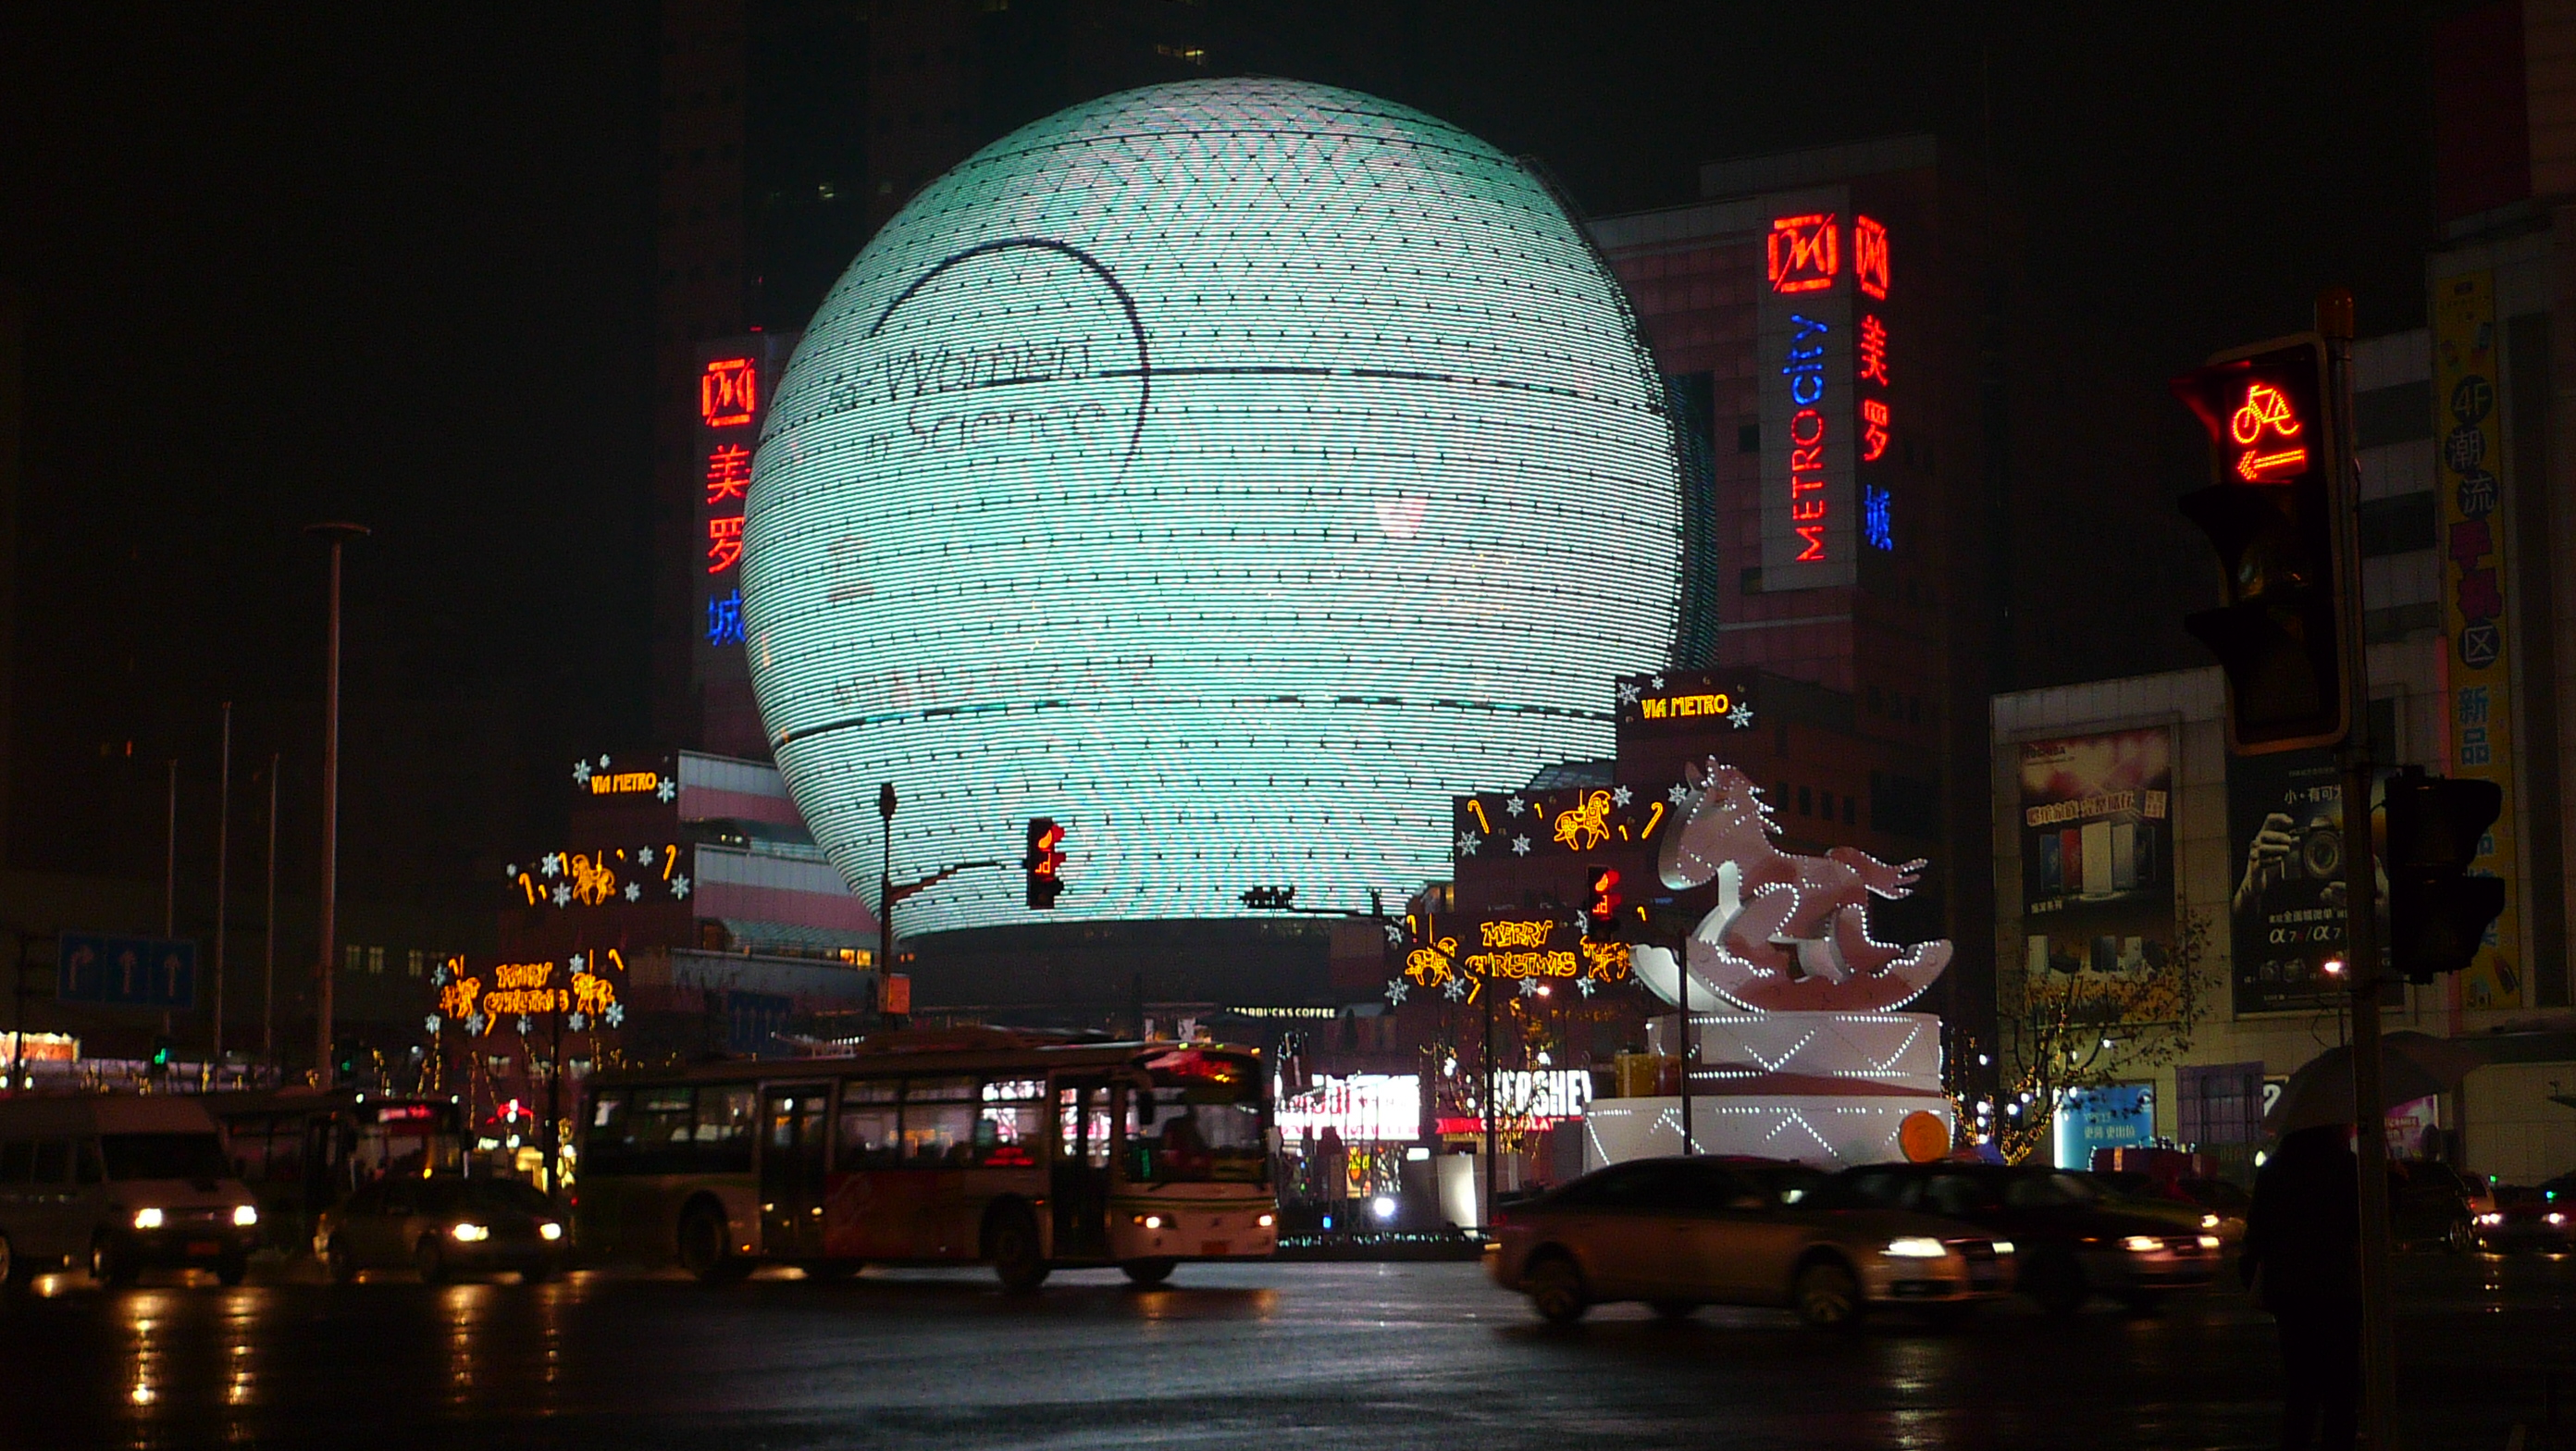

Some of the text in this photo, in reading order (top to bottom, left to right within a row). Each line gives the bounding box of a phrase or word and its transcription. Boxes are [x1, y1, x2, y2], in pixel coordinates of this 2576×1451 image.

[1641, 693, 1728, 719] VIA METRO
[612, 772, 657, 793] METRO
[1480, 920, 1554, 949] MERRY
[1294, 1008, 1335, 1019] COFFEE
